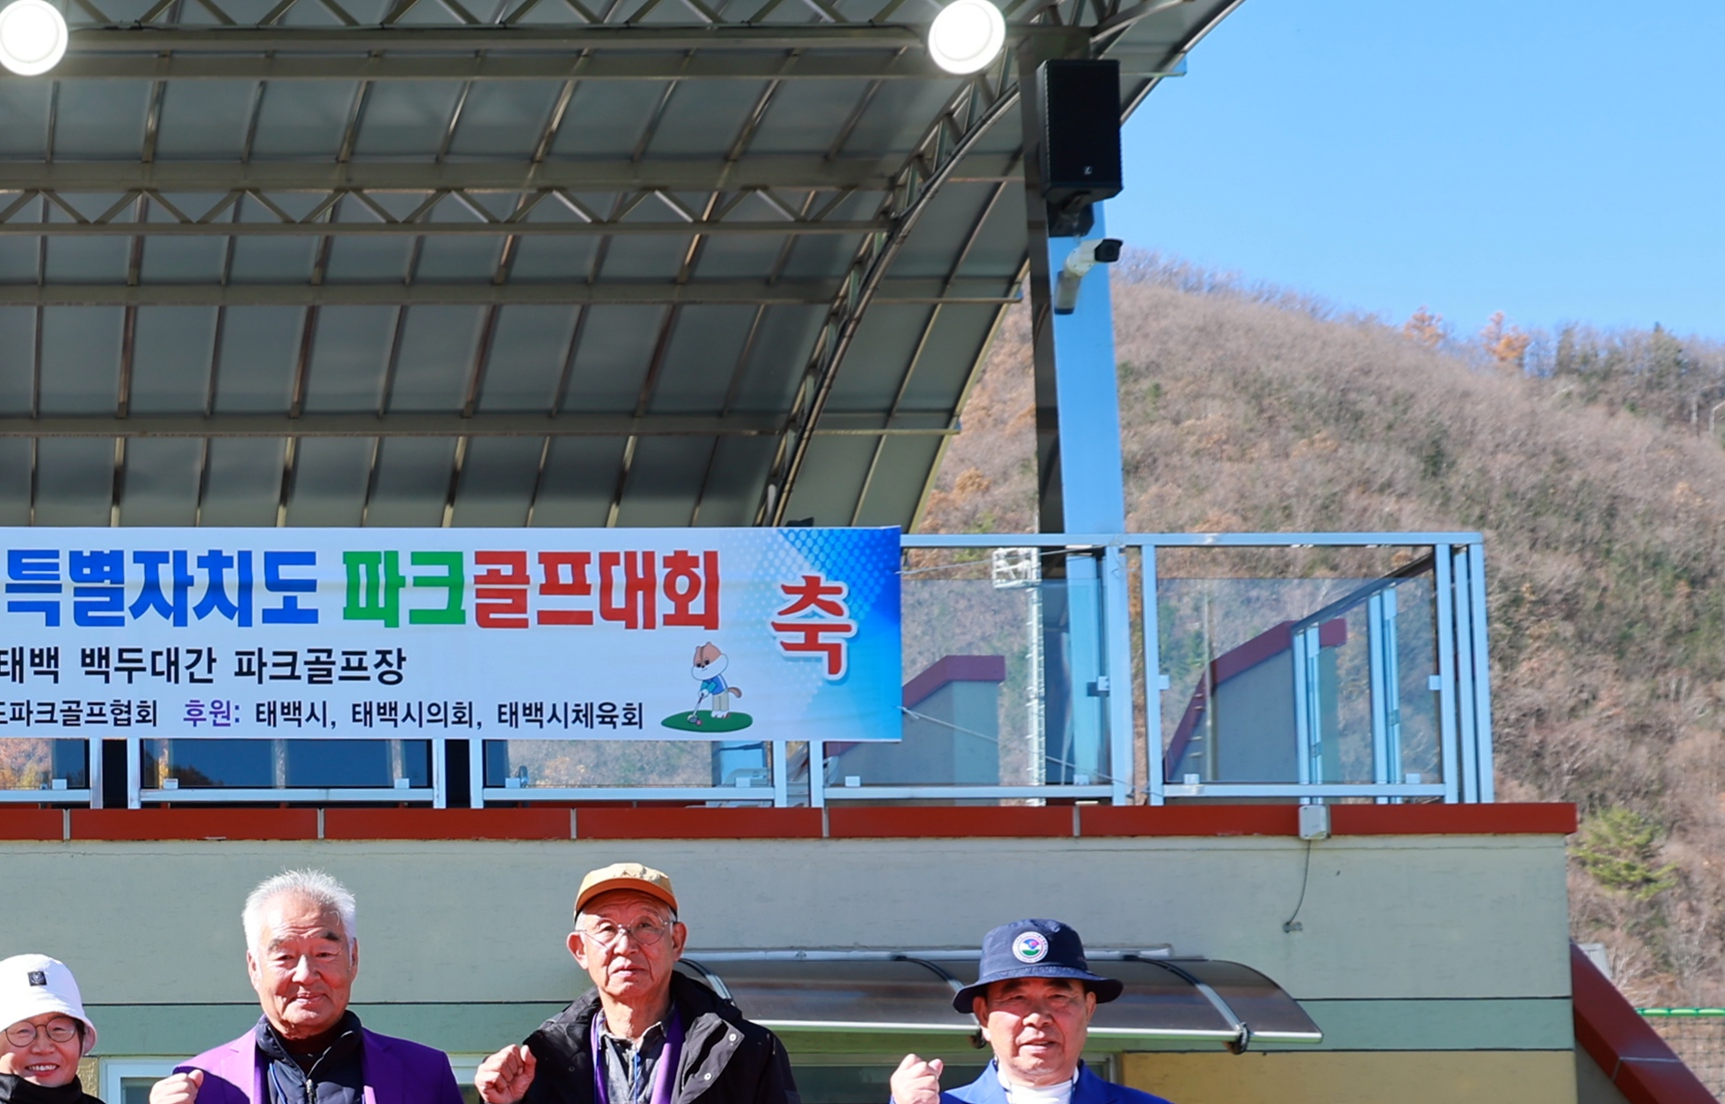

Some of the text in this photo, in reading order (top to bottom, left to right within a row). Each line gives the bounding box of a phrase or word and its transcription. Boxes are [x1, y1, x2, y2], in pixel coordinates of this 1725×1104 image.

[342, 549, 719, 631] 파크골프대회
[771, 575, 853, 676] 축
[80, 646, 218, 686] 백두대간
[233, 646, 407, 686] 파크골프장
[182, 699, 241, 728] 후원:
[255, 699, 338, 730] 태백시,
[351, 700, 484, 731] 태백시의회,
[497, 701, 644, 731] 태백시체육회
